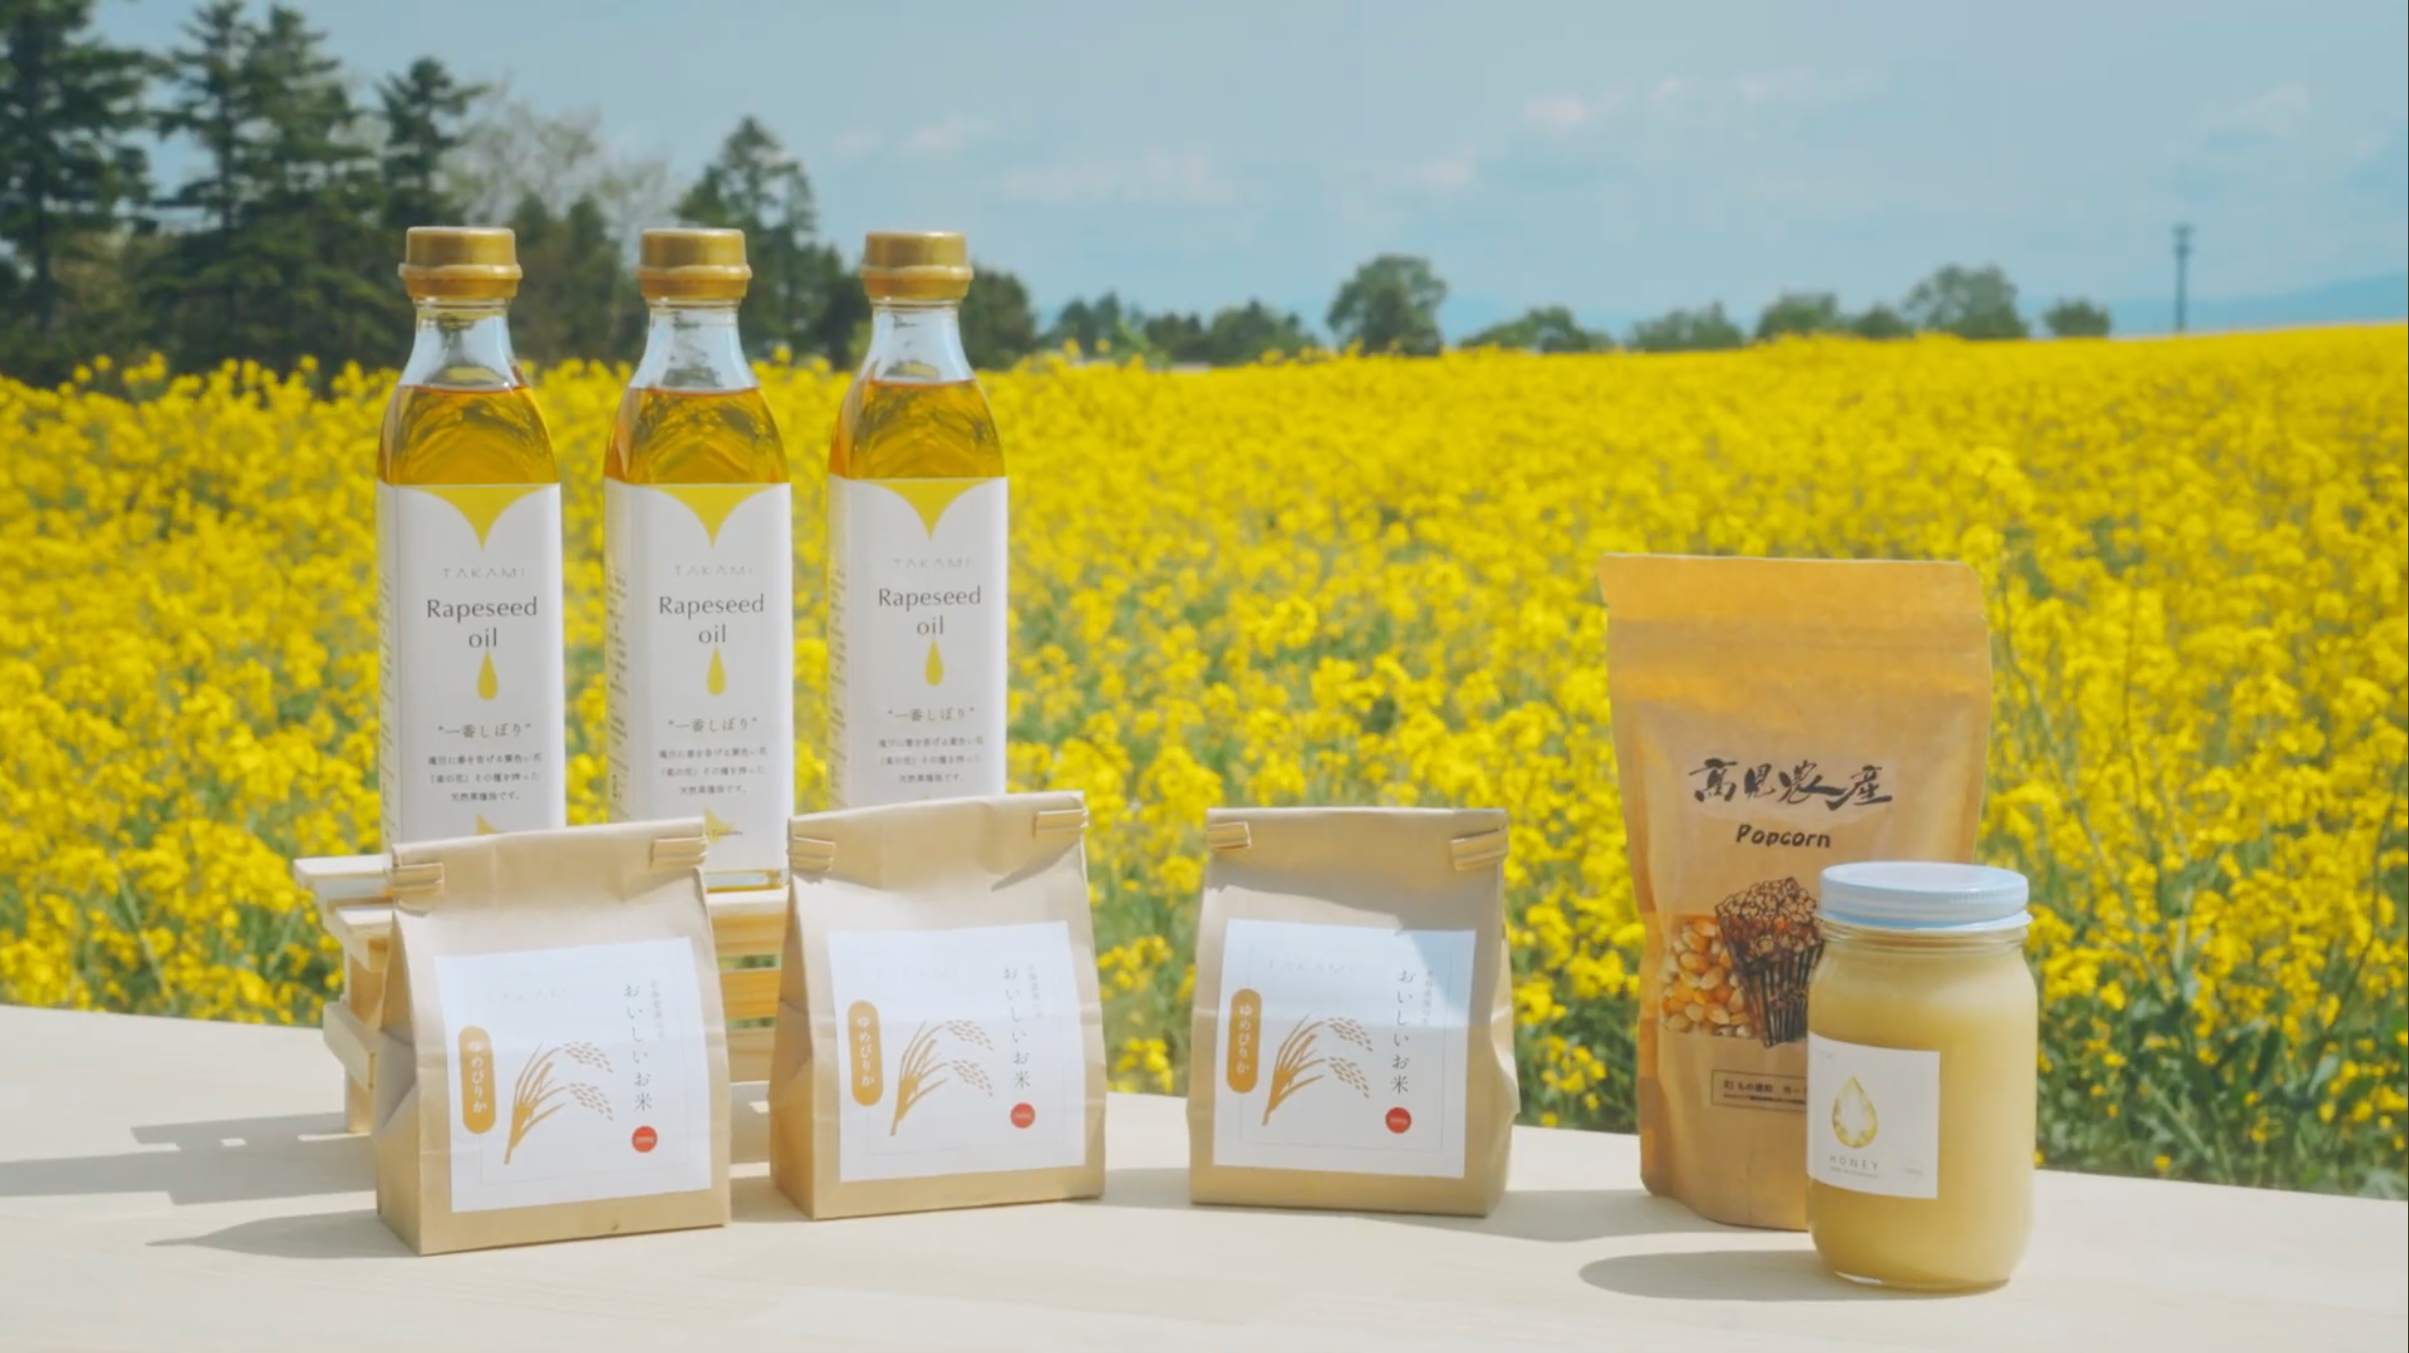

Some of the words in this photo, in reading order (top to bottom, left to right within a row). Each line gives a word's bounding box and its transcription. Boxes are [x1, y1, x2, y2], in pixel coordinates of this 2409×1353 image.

[442, 567, 526, 580] TAKAMI
[672, 564, 753, 577] TAKAMI
[892, 557, 973, 570] TAKAMI
[426, 595, 539, 623] Rapeseed
[658, 593, 766, 622] Rapeseed
[877, 585, 982, 612] Rapeseed
[468, 627, 498, 649] oil
[697, 624, 727, 645] oil
[915, 616, 945, 636] oil
[1735, 823, 1832, 849] Popcorn
[1002, 965, 1032, 1090] おいしいお米
[1236, 1003, 1253, 1075] ゆめびりか
[1389, 969, 1416, 1095] おいしいお米
[623, 982, 654, 1114] おいしいお米
[856, 1016, 876, 1088] ゆめびりか
[466, 1040, 488, 1114] ゆめびりか
[1829, 1154, 1880, 1171] HONEY
